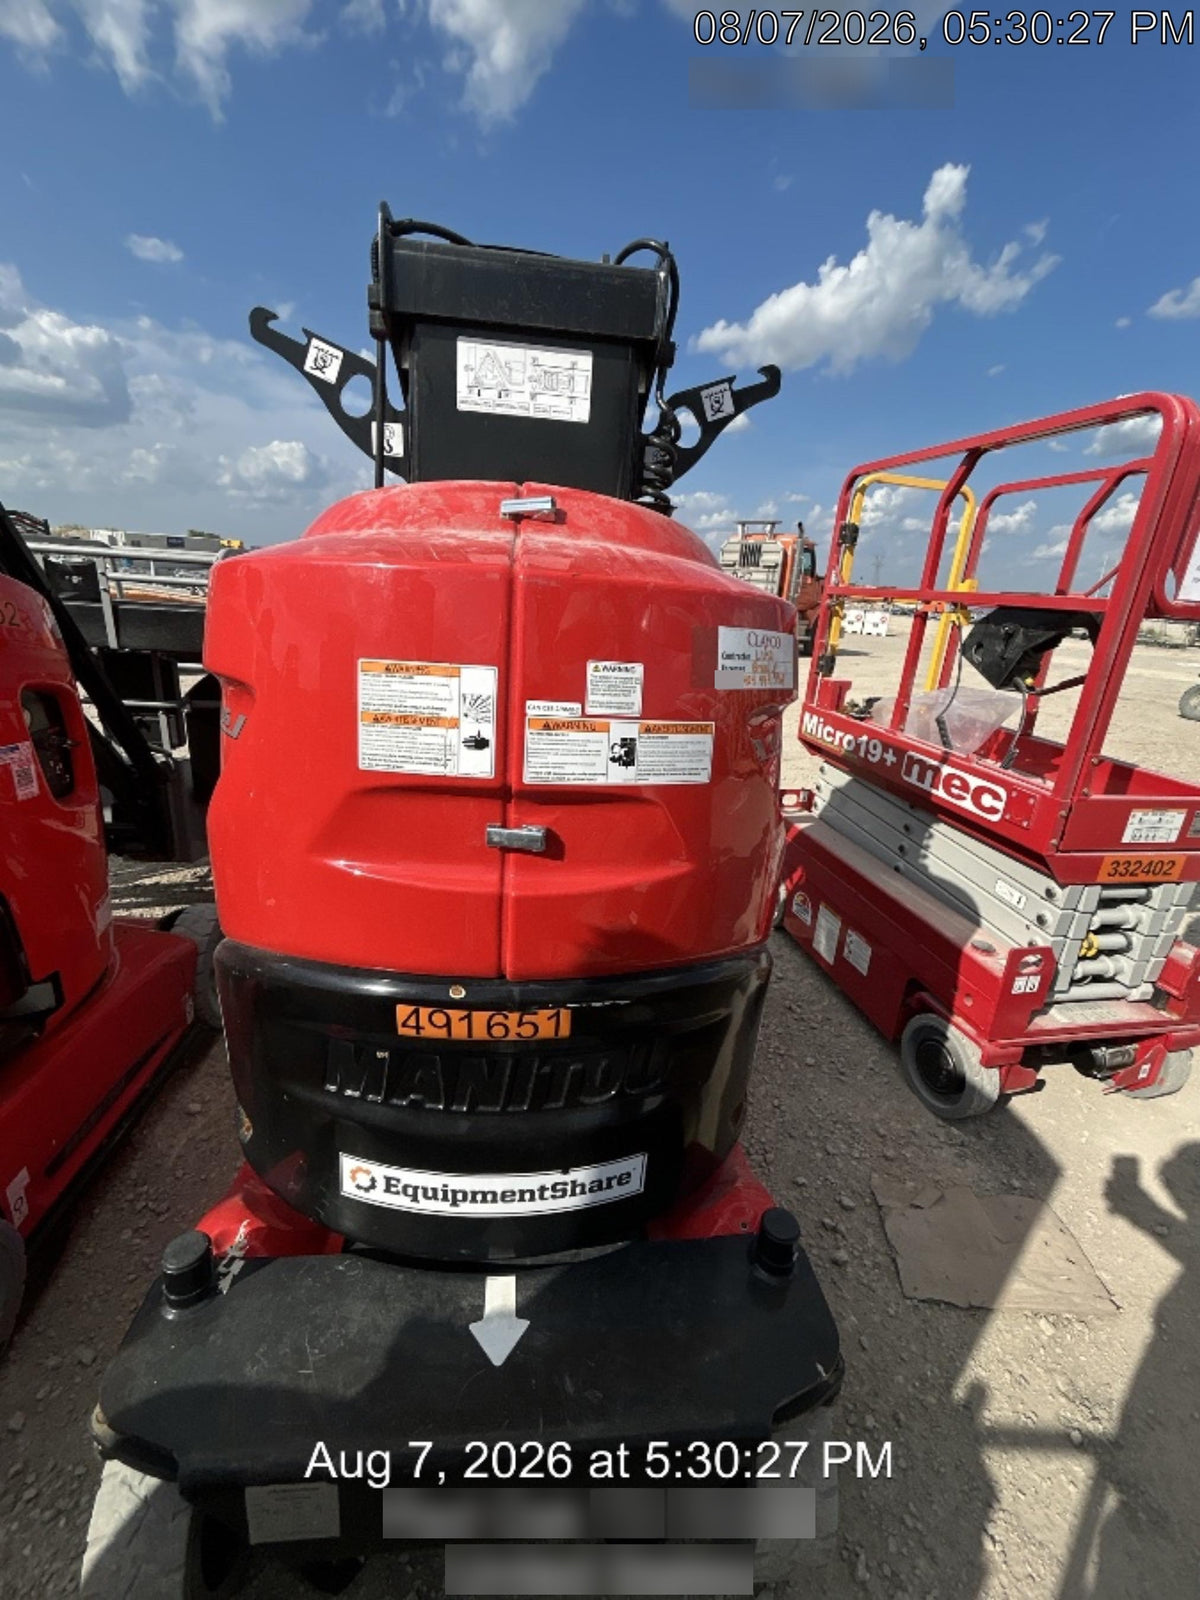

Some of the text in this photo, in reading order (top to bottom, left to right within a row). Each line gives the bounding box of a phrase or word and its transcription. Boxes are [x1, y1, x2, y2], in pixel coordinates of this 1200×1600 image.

[903, 753, 1005, 816] mec
[1107, 860, 1176, 877] 332402
[401, 1007, 563, 1039] 491651
[383, 1170, 632, 1207] EquipmentShare
